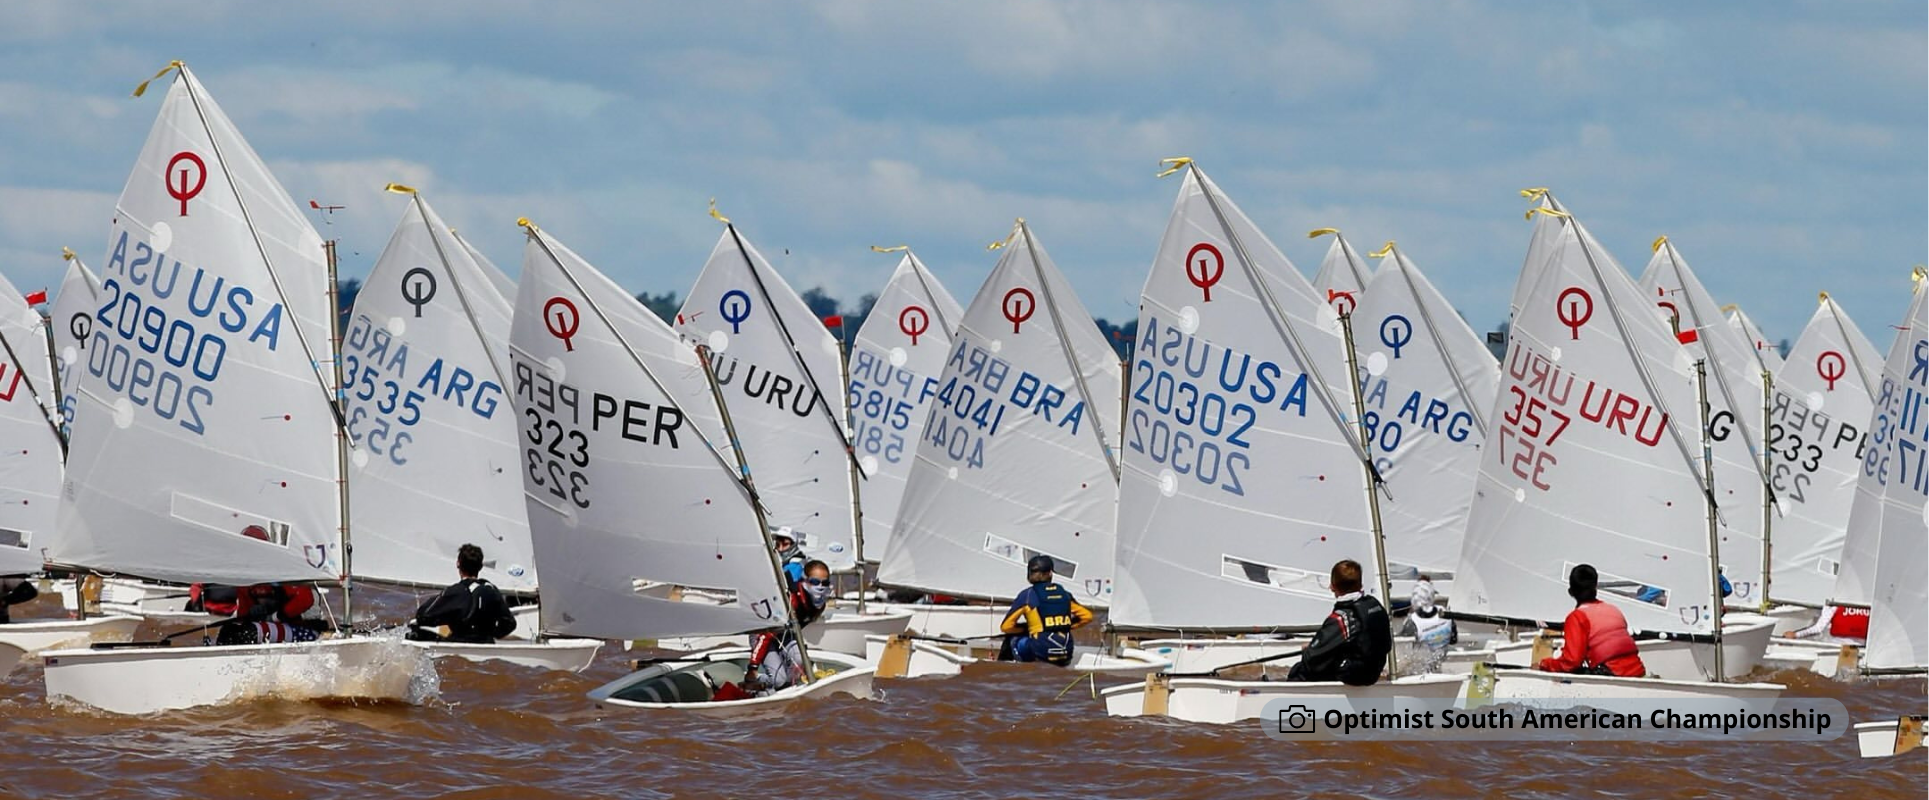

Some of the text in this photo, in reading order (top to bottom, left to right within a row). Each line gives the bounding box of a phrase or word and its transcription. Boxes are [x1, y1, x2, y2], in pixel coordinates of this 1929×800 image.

[97, 279, 226, 382] 20900
[188, 268, 283, 351] USA
[343, 356, 425, 426] 3535
[417, 358, 502, 419] ARG
[743, 365, 818, 417] URU
[850, 380, 914, 430] 5815
[938, 377, 1006, 436] 4041
[1010, 371, 1085, 436] BRA
[1134, 360, 1256, 449] 20302
[1219, 348, 1308, 417] USA
[526, 408, 589, 468] 323
[593, 393, 683, 449] PER
[1397, 390, 1473, 442] ARG
[1504, 385, 1571, 446] 357
[1579, 381, 1669, 447] URU
[1770, 424, 1823, 472] 233
[1045, 616, 1072, 627] BRA
